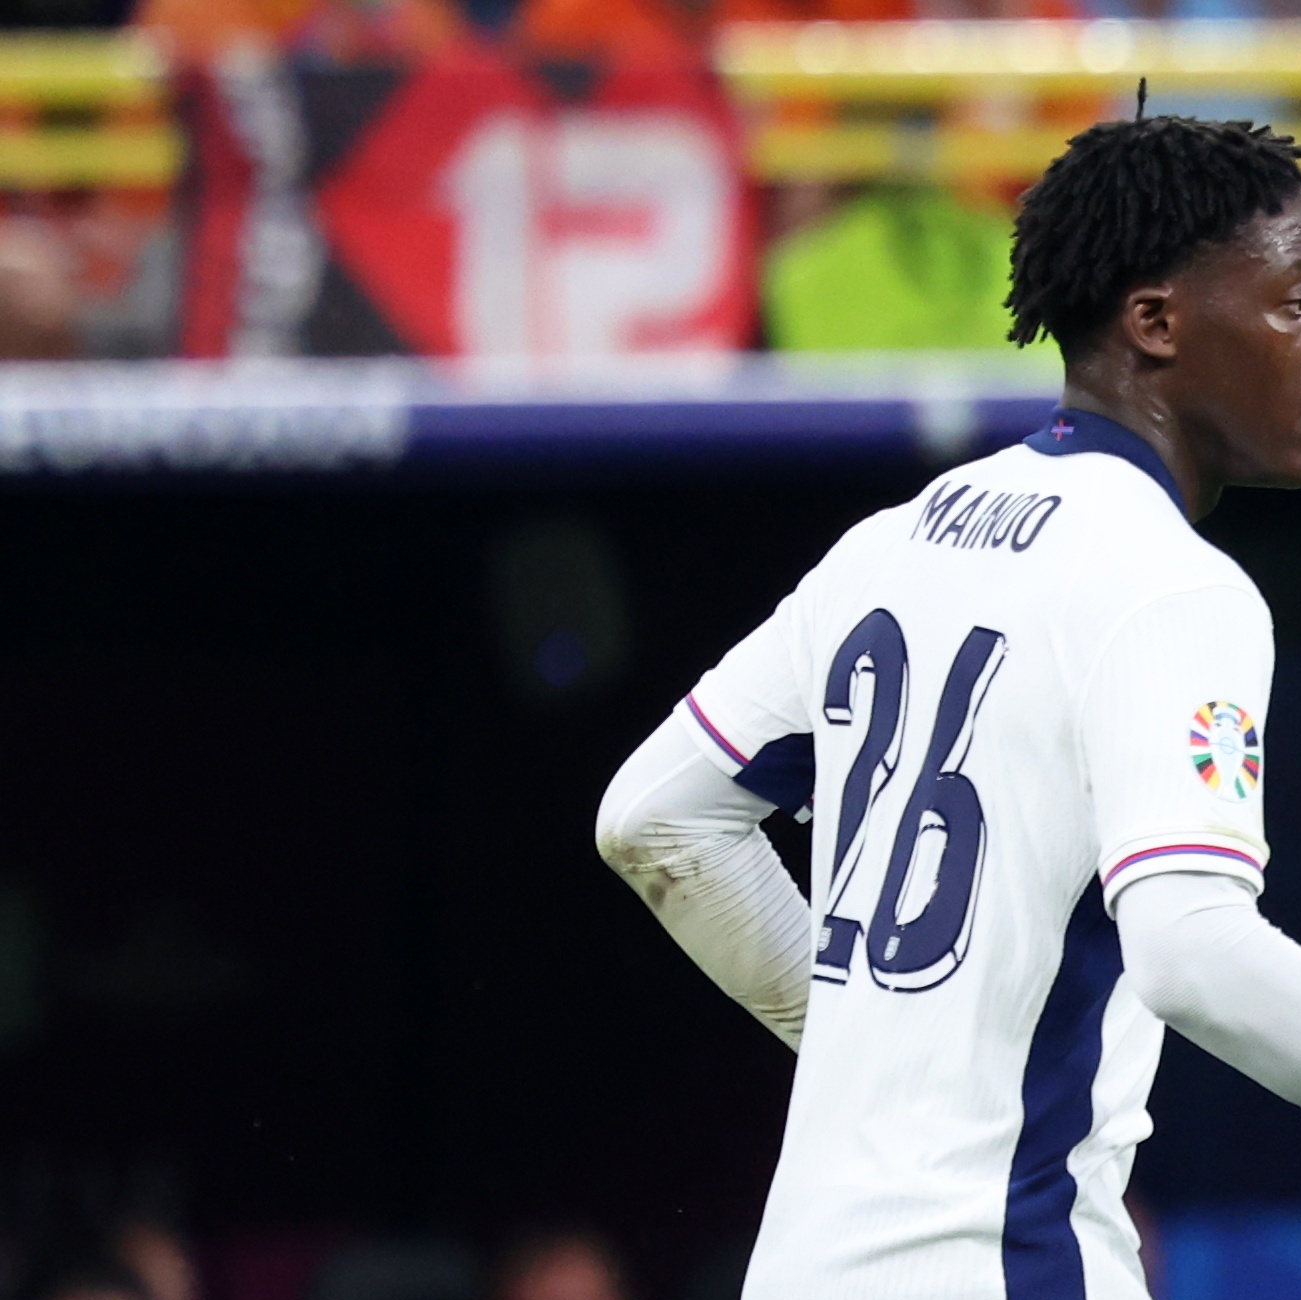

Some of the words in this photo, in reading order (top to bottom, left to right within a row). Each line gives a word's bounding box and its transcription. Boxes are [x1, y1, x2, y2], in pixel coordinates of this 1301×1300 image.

[436, 110, 736, 370] 12
[909, 480, 1062, 554] MAINOO
[811, 606, 1010, 994] 26
